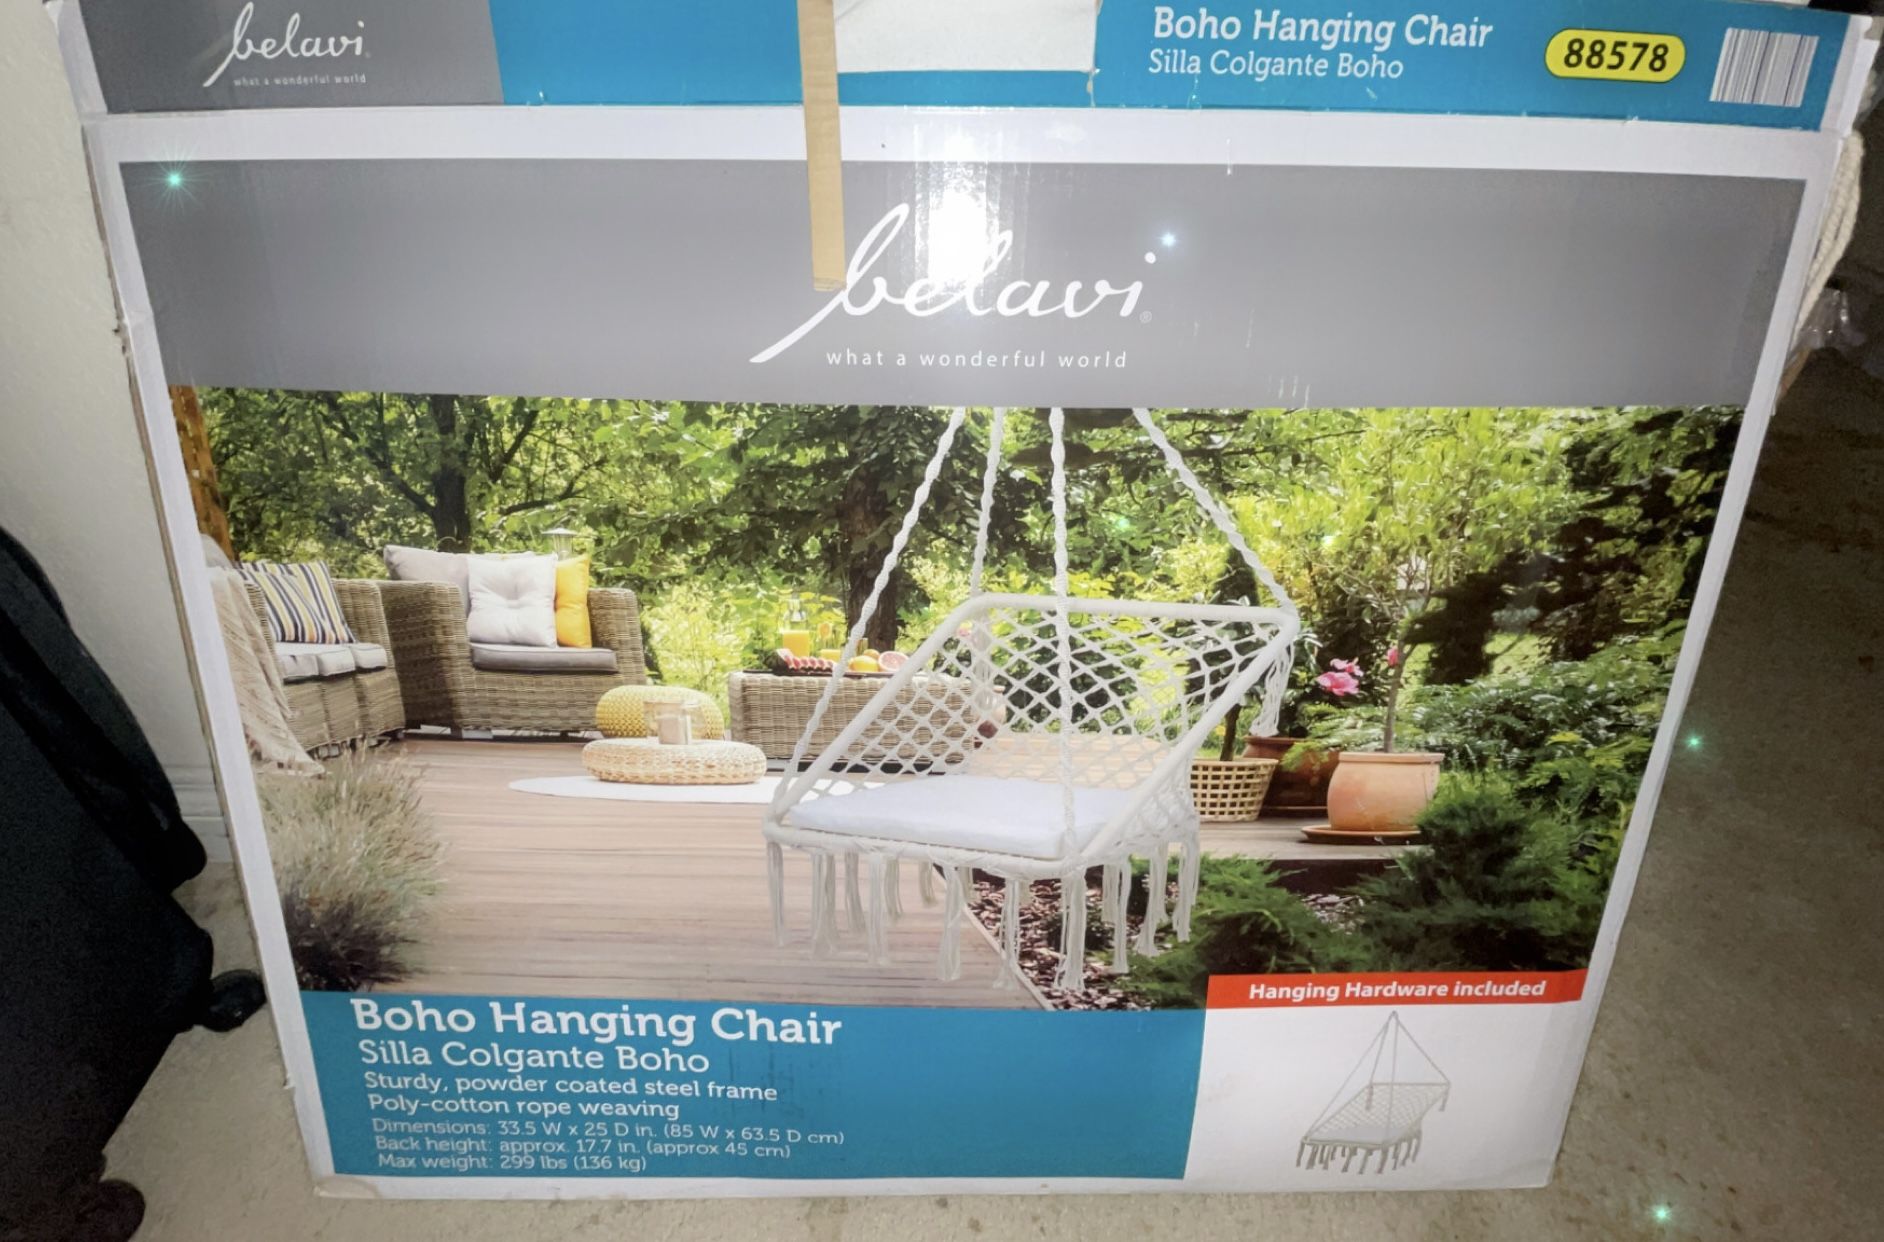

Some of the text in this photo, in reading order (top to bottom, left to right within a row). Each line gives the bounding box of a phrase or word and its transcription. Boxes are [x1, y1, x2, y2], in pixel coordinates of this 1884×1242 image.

[1154, 7, 1493, 52] Boho Hanging Chair
[203, 2, 364, 87] belavi
[1563, 38, 1669, 72] 88578
[1149, 48, 1404, 81] Silla Colgante Boho
[234, 75, 260, 86] what
[274, 74, 330, 85] wonderful
[335, 74, 366, 84] world
[749, 203, 1157, 363] belavi
[826, 349, 1127, 368] what a wonderful world
[1250, 980, 1547, 1002] Hanging Hardware included
[350, 998, 842, 1046] Boho Hanging Chair
[358, 1040, 709, 1073] Silla Colgante Boho
[364, 1071, 777, 1100] Sturdy, powder coated steel frame
[368, 1093, 679, 1121] Poly-cotton rope weaving
[372, 1118, 845, 1145] Dimensions: 33.5 W x 25 D in. (85 W x 63.5 D cm)
[375, 1135, 791, 1159] Back height: approx. 17.7 in. (approx 45 cm)
[378, 1153, 646, 1173] Max weight: 299 lbs (136 kg)
